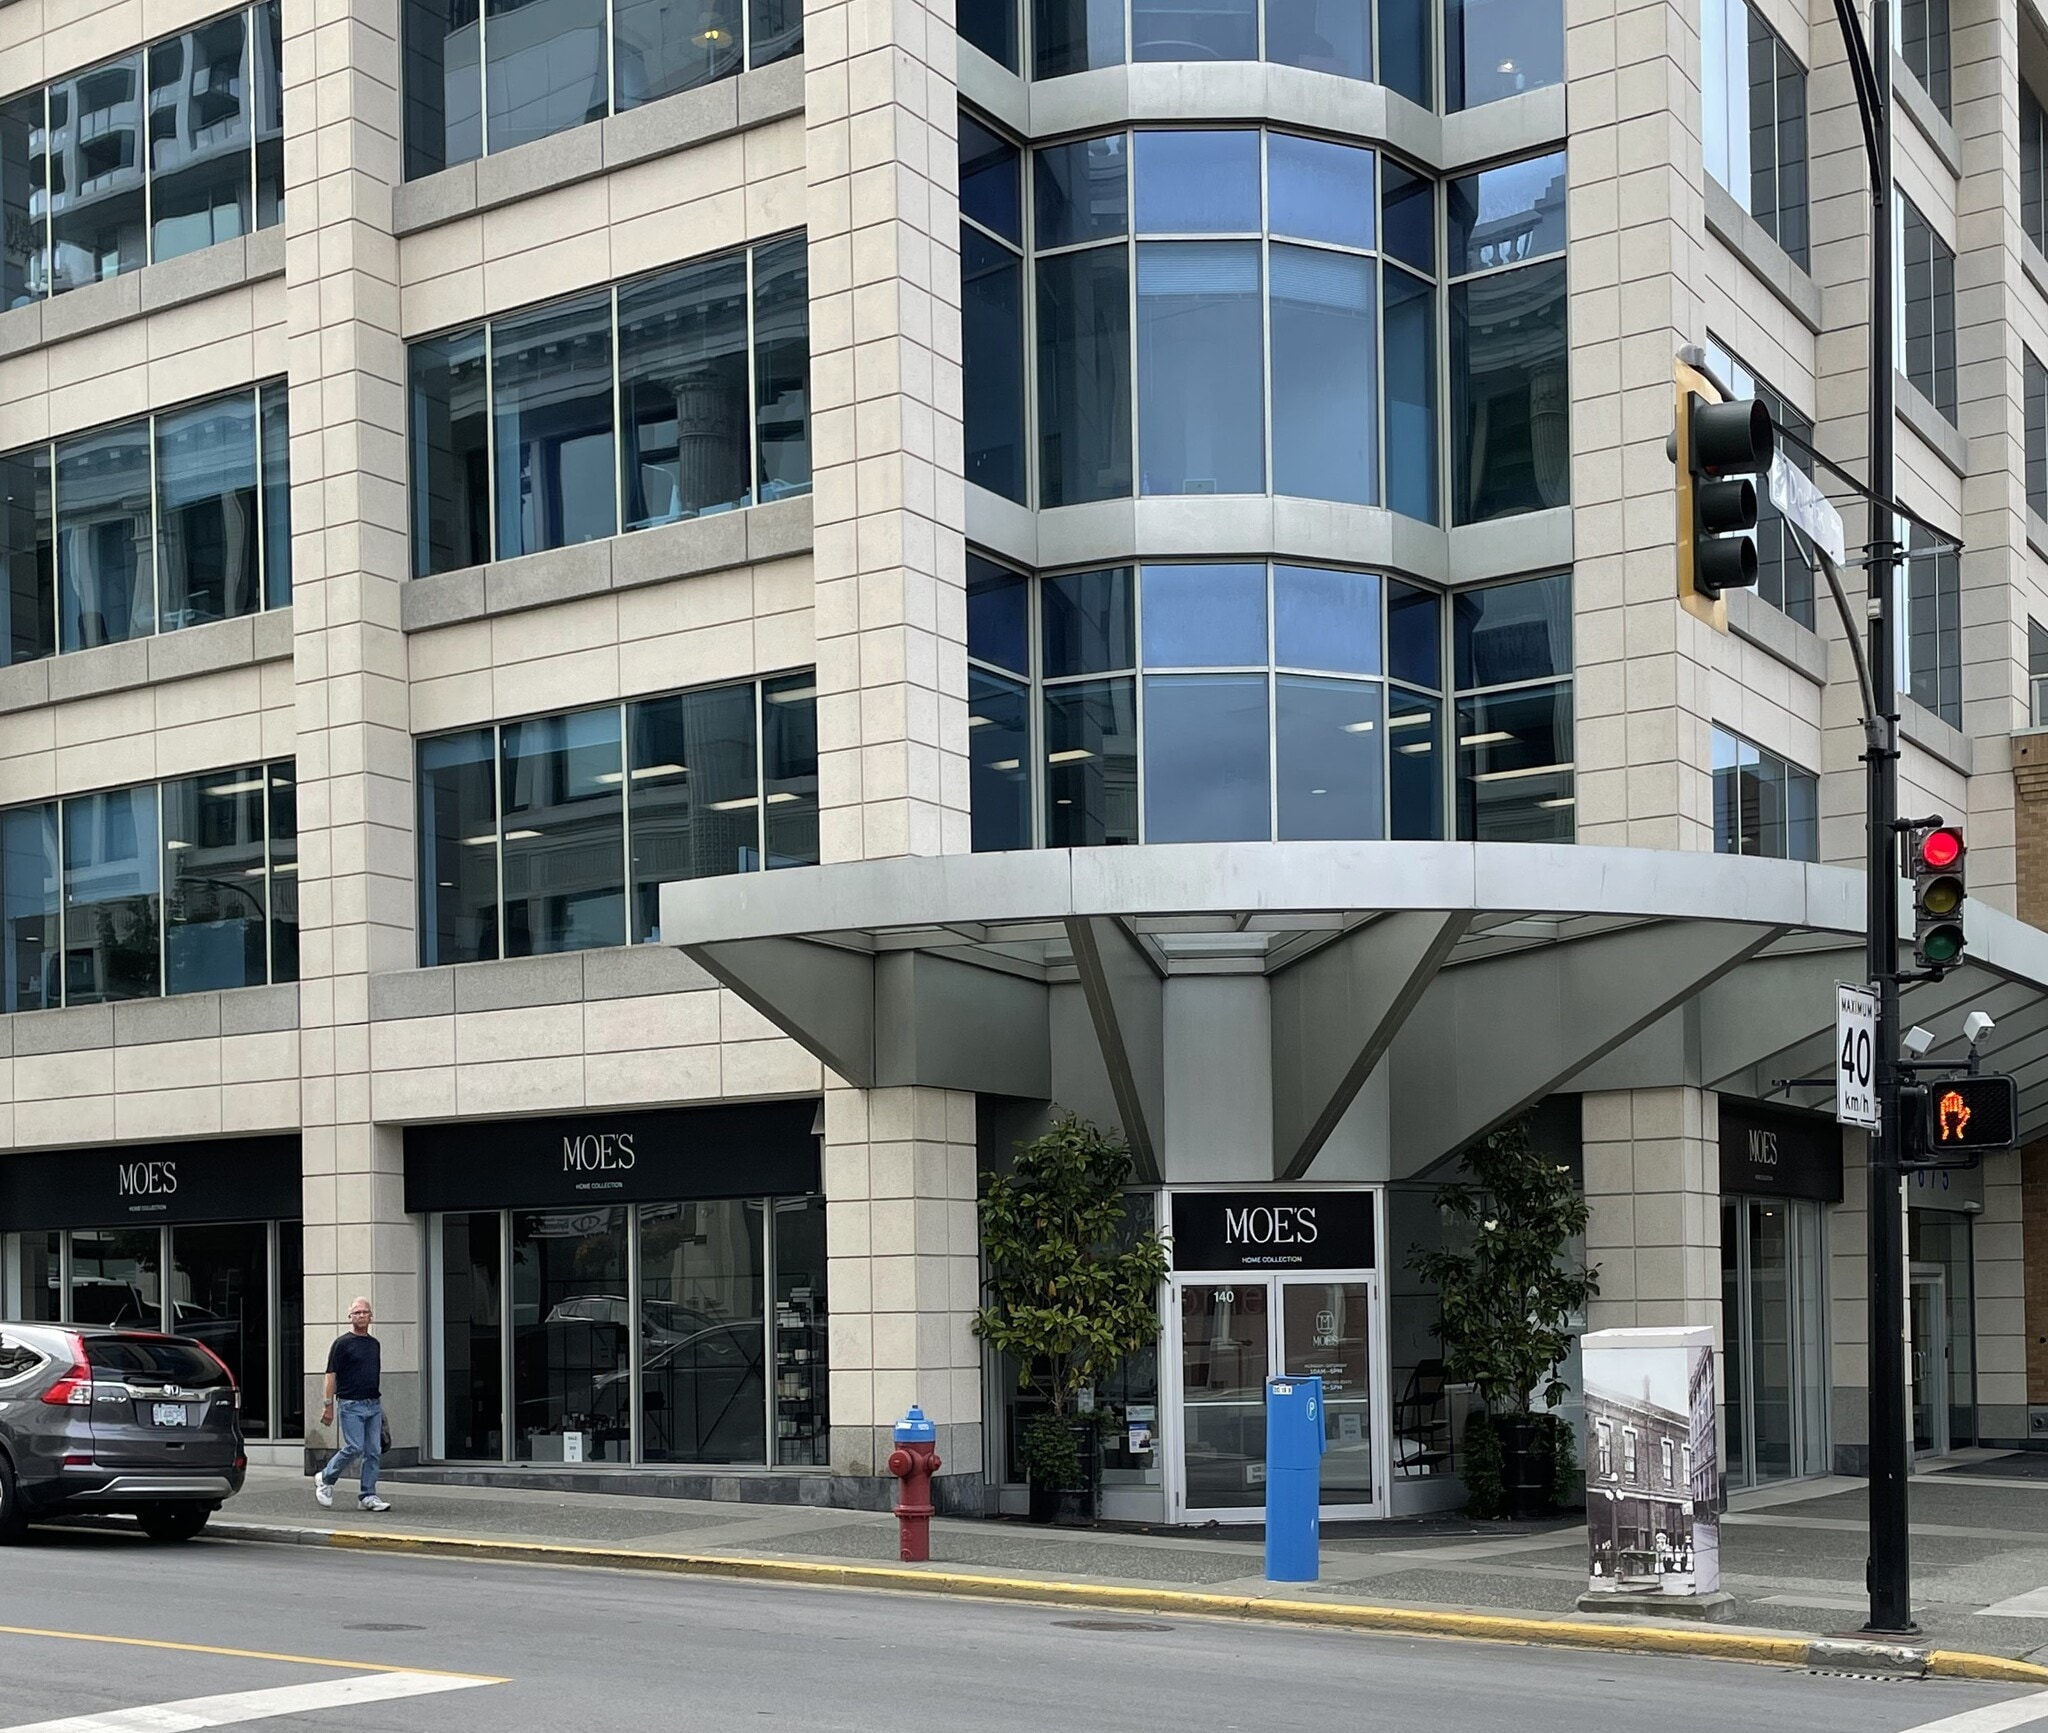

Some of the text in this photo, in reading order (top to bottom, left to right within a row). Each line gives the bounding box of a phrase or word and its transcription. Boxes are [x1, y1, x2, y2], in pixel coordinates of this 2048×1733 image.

[1841, 997, 1873, 1018] MAXIMUM
[1841, 1027, 1871, 1088] 40
[1845, 1090, 1870, 1114] km/h
[563, 1133, 636, 1171] MOE'S
[119, 1161, 178, 1195] MOE'S
[1225, 1207, 1318, 1244] MOE'S
[1213, 1290, 1235, 1303] 140
